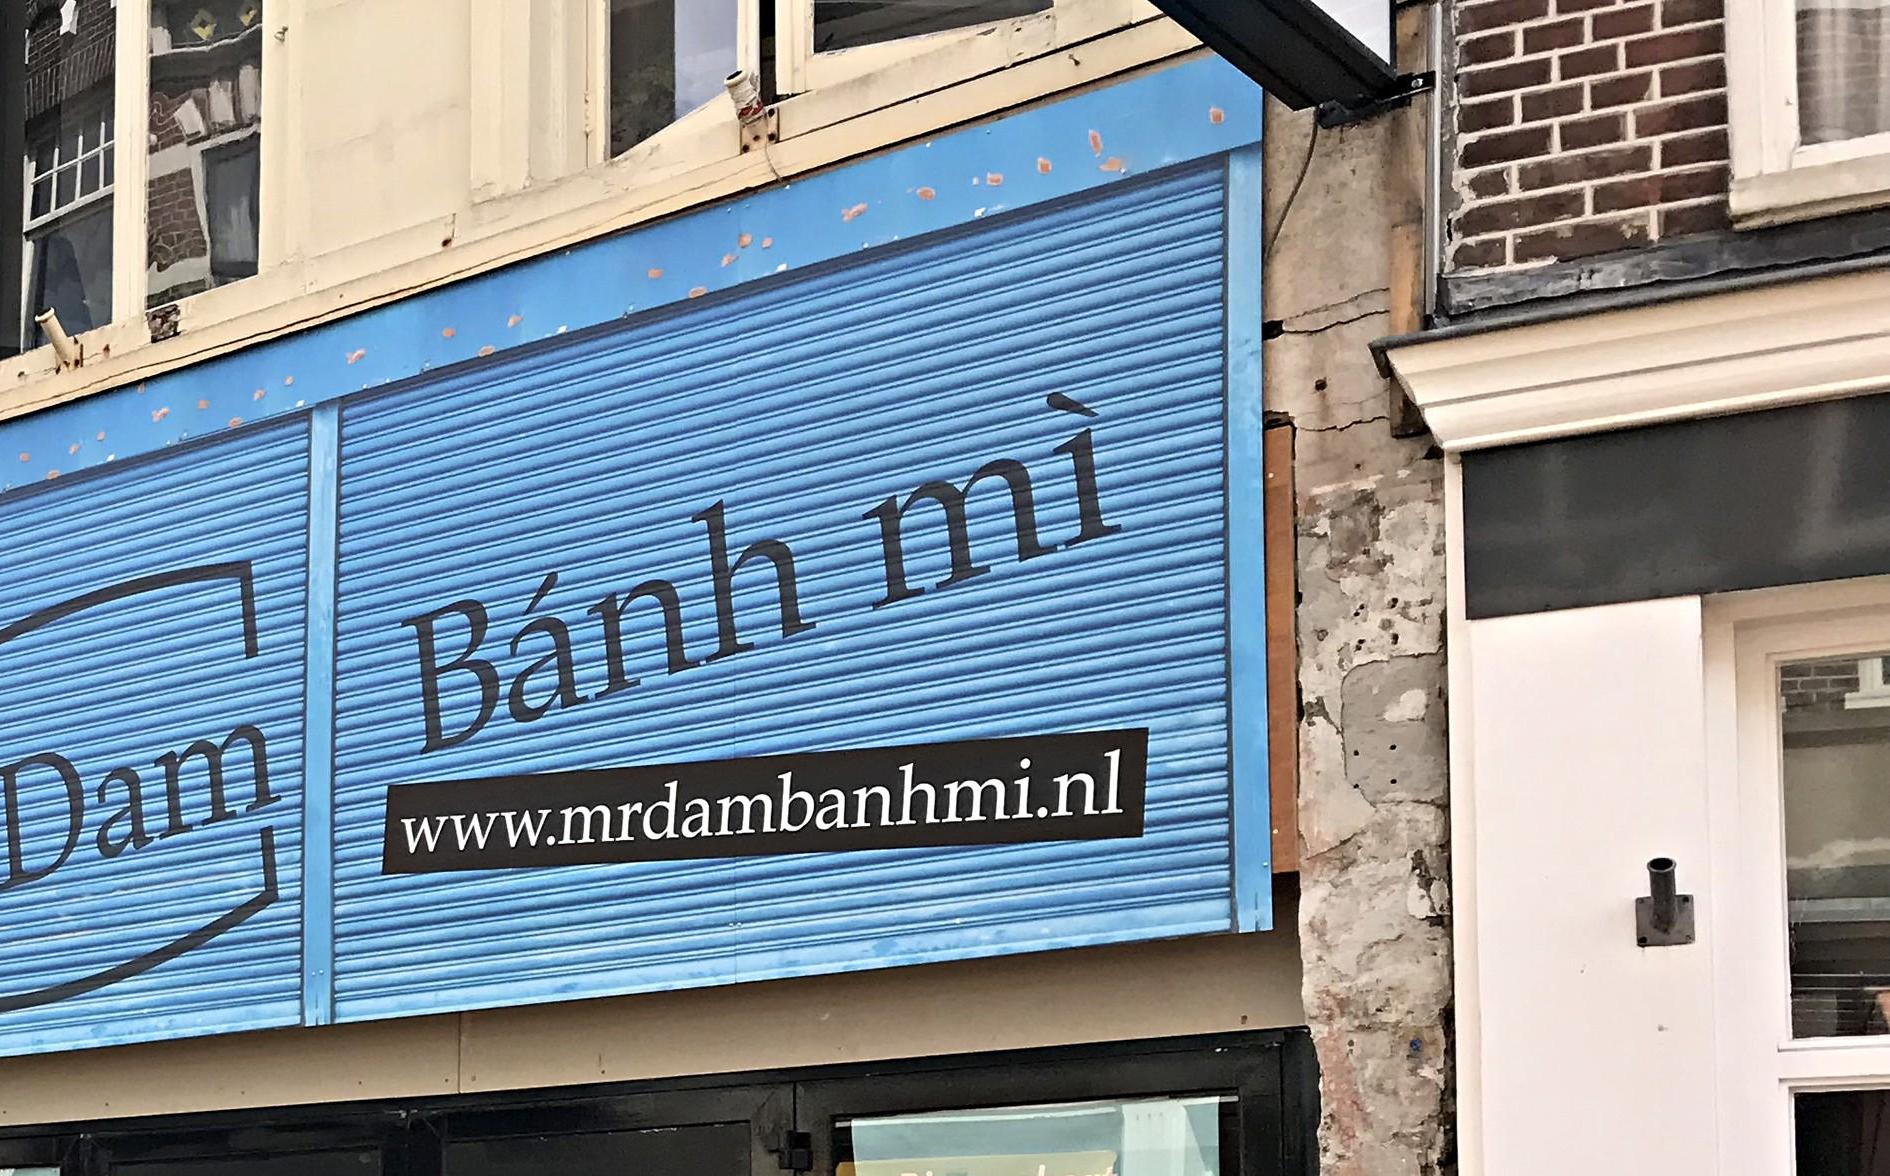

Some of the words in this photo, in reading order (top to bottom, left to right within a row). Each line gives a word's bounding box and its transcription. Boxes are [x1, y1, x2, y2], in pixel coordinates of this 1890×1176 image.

[401, 498, 817, 755] Bánh
[861, 390, 1123, 611] mì
[399, 747, 1124, 856] www.mrdambanhmi.nl
